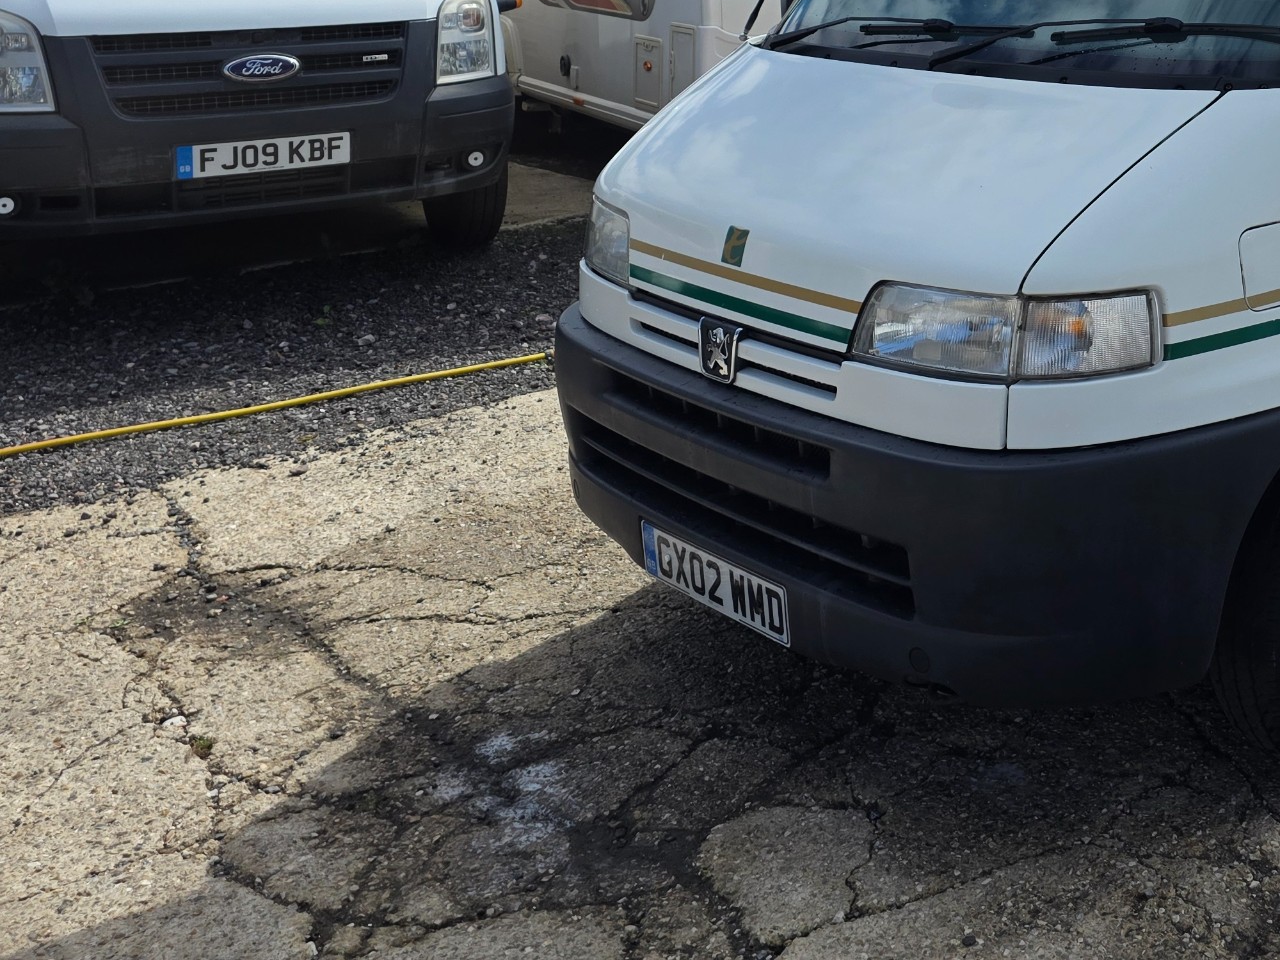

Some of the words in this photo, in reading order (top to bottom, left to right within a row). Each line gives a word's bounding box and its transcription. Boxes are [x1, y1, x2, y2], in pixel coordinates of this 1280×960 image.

[241, 59, 283, 75] Ford
[199, 143, 279, 173] FJ09
[288, 136, 344, 164] KBF
[656, 535, 724, 606] GX02
[728, 568, 785, 636] WMD
